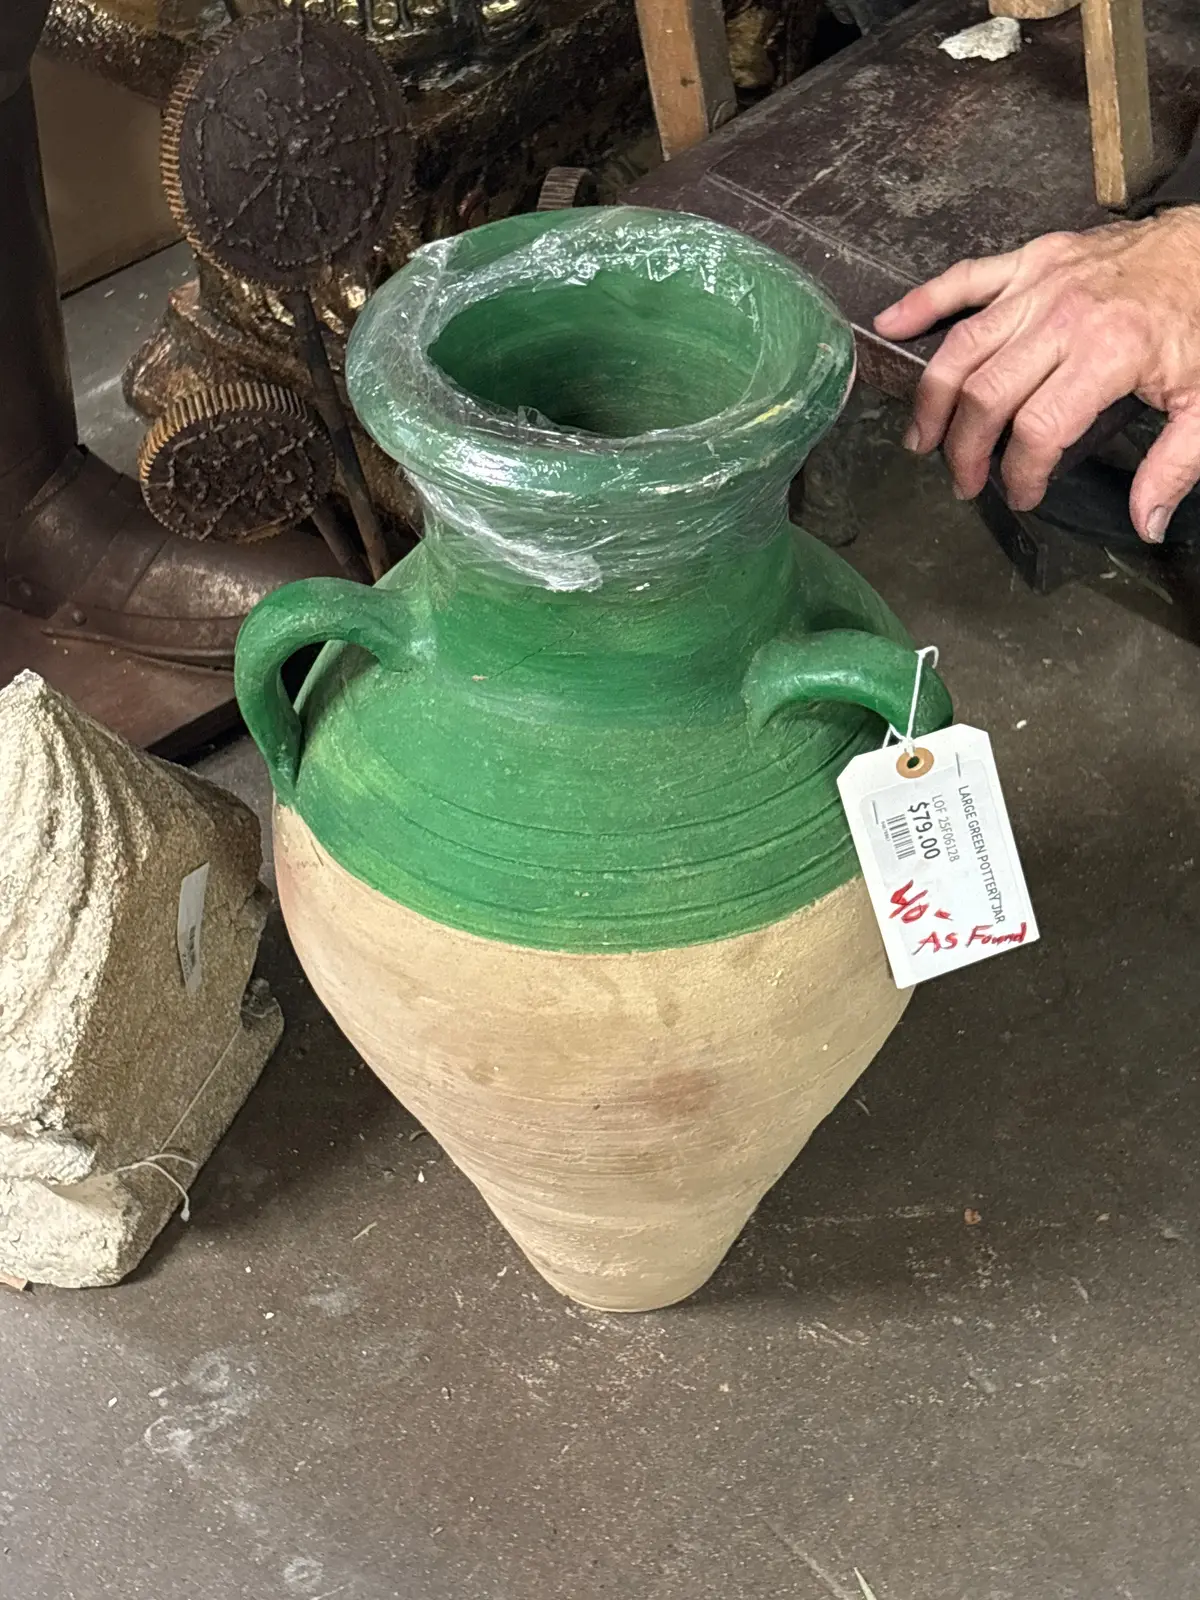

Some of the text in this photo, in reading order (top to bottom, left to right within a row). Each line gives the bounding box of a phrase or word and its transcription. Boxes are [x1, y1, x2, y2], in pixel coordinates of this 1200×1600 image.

[907, 801, 941, 859] $79.00
[932, 794, 960, 862] LOF 25F06128
[958, 785, 1006, 924] LARGE GREEN POTTERY JAR
[965, 922, 1027, 948] Found
